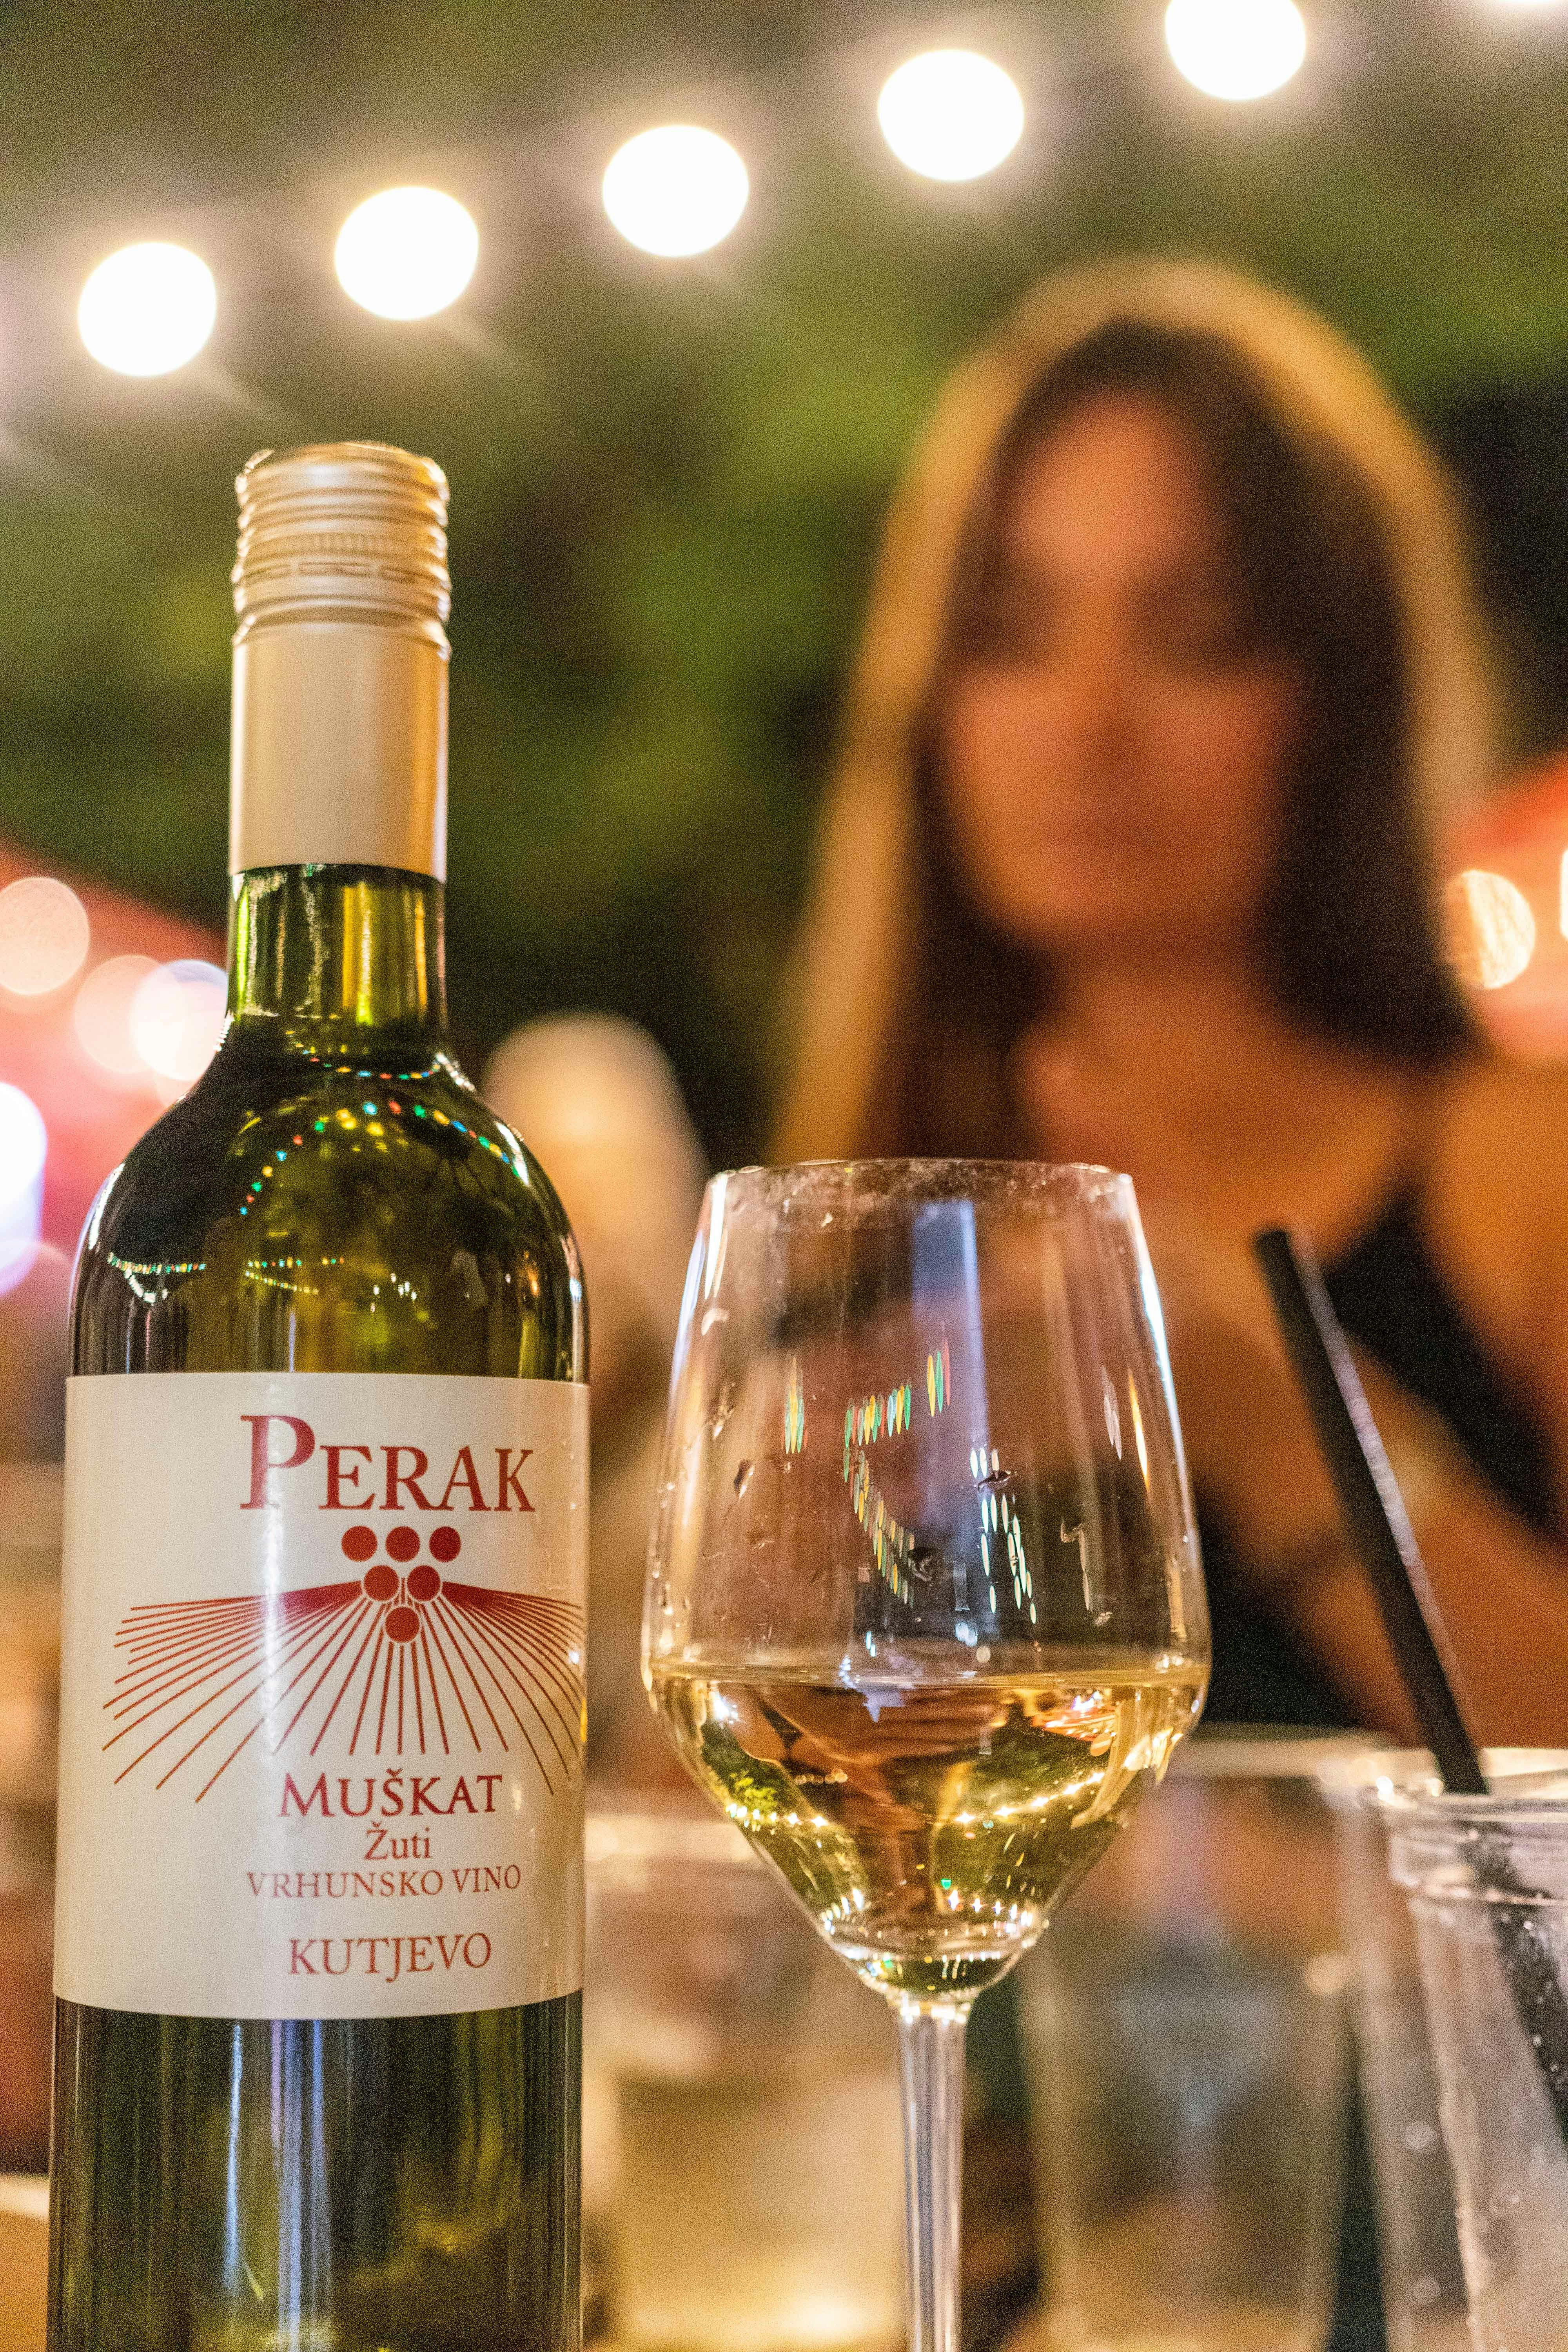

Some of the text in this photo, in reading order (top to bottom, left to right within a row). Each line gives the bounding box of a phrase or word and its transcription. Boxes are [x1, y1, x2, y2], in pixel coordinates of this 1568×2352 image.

[240, 1414, 535, 1512] PERAK
[279, 1768, 503, 1817] MUŠKAT
[364, 1821, 431, 1860] Žuti
[247, 1864, 522, 1897] VRHUNSKO VINO
[289, 1932, 492, 1984] KUTJEVO
